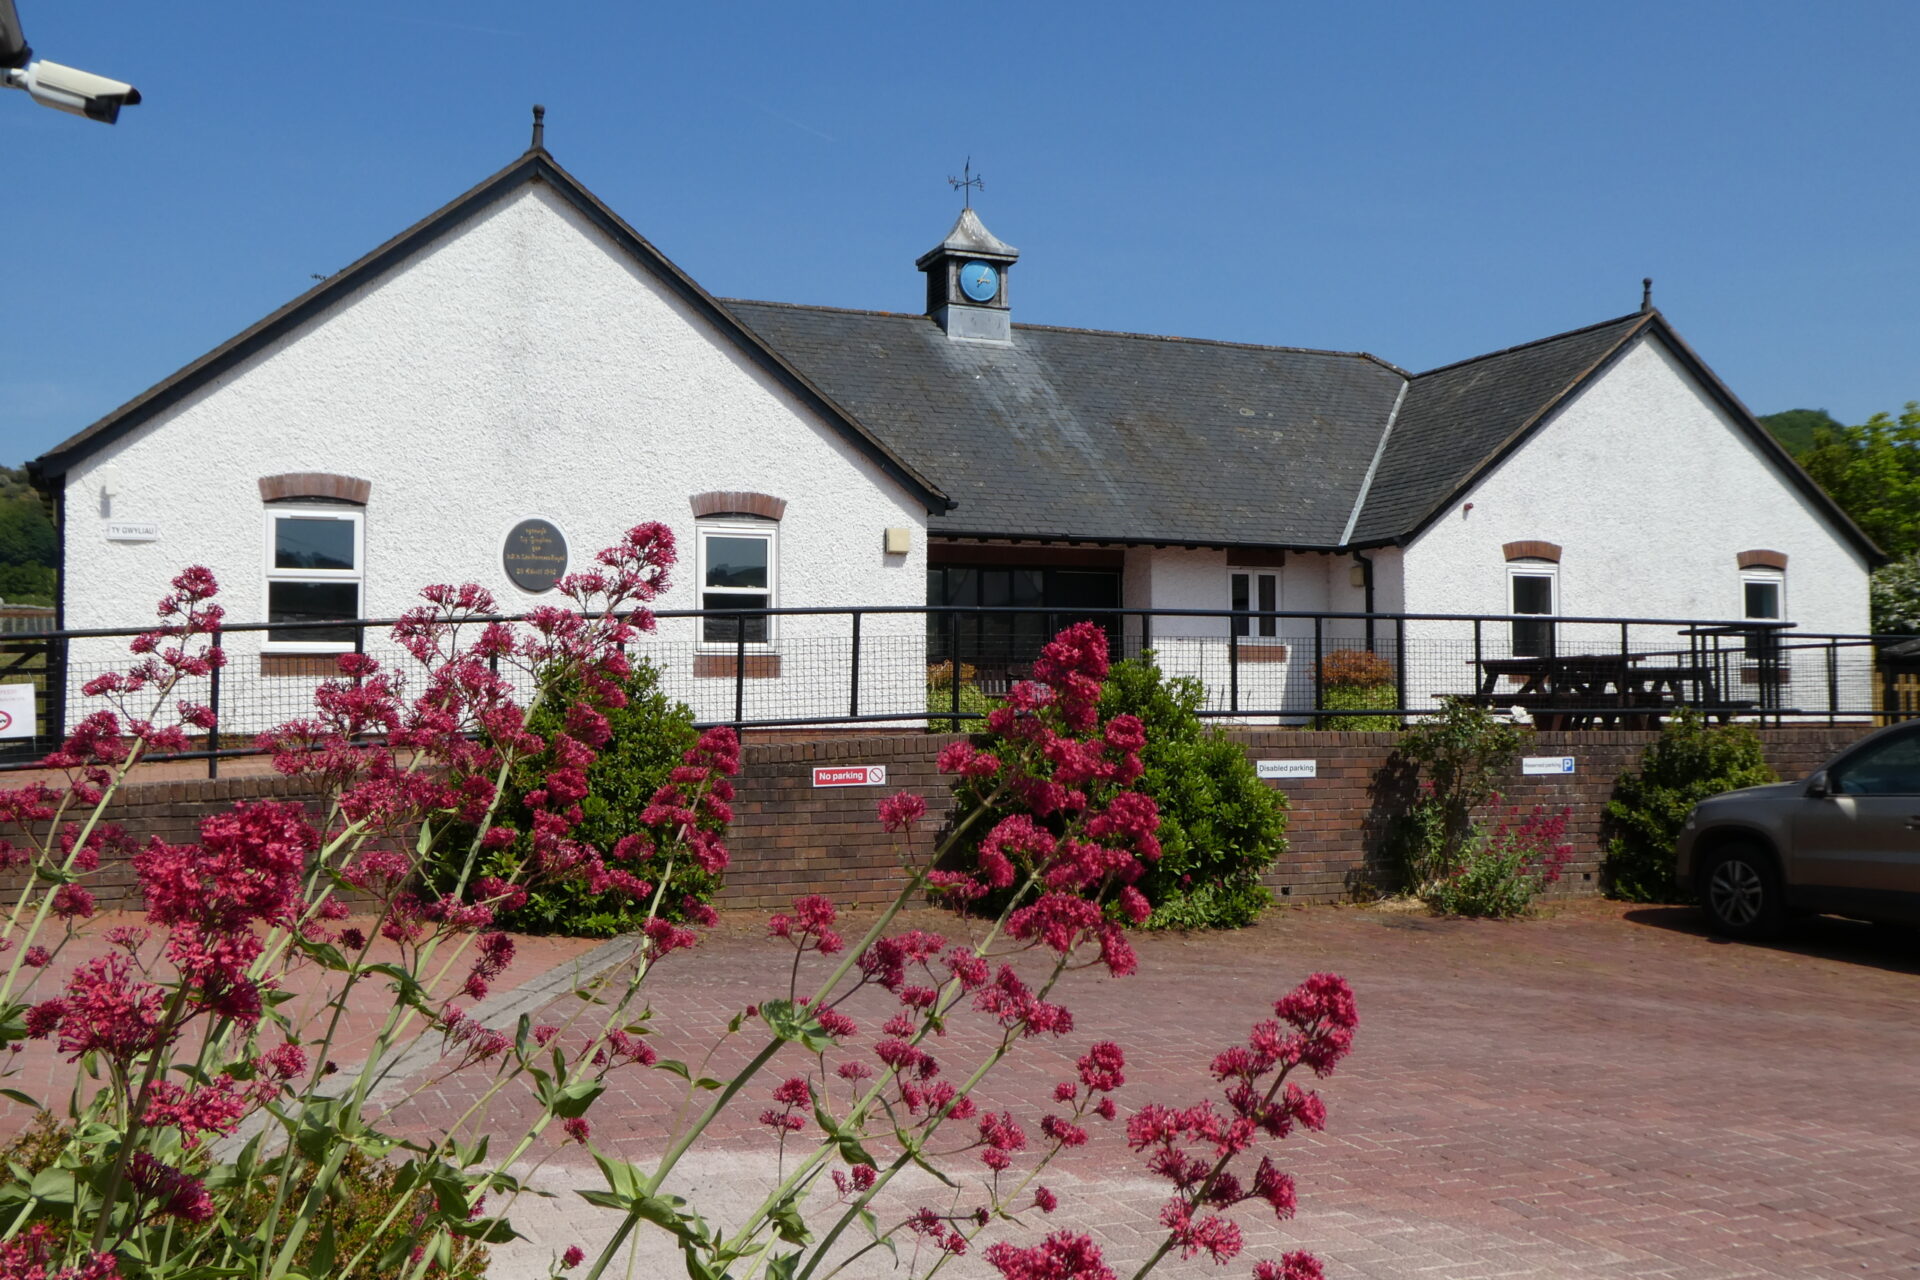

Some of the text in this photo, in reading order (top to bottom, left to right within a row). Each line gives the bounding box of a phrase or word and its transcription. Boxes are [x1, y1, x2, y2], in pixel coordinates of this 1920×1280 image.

[1259, 764, 1314, 773] Disabled parking
[819, 771, 864, 782] No parking
